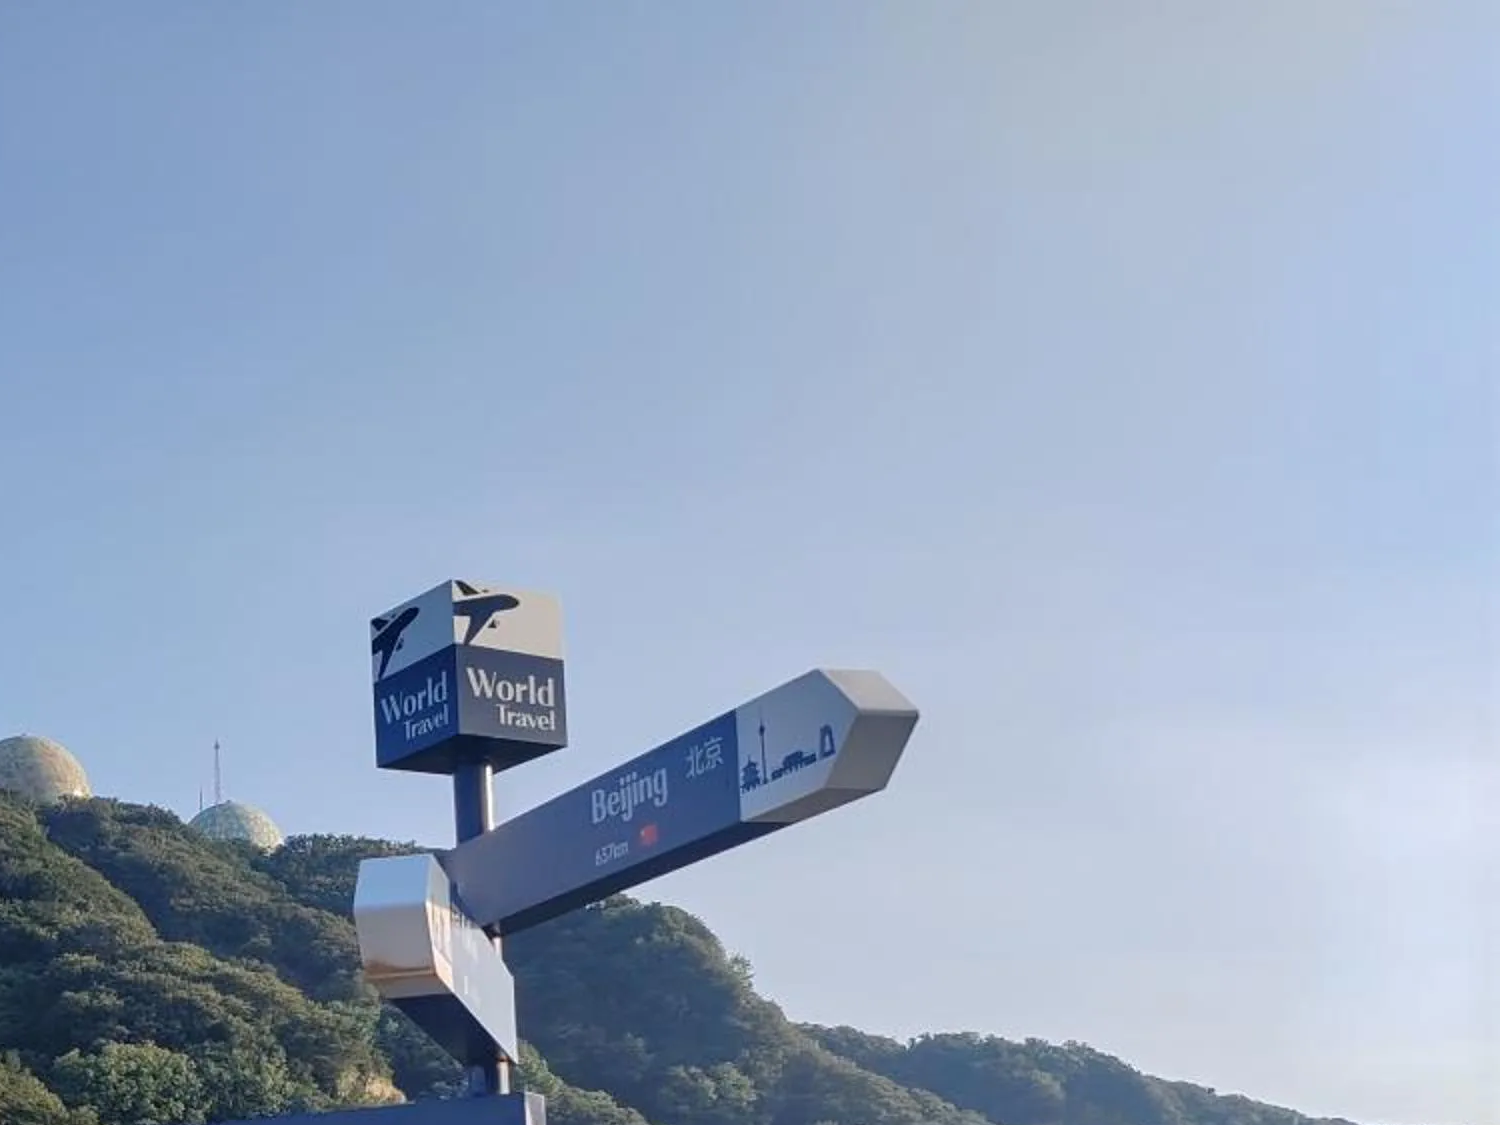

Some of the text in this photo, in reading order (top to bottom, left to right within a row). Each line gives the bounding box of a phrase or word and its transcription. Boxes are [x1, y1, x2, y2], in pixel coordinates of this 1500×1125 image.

[380, 671, 448, 725] World
[466, 667, 555, 707] World
[403, 704, 449, 741] Travel
[496, 703, 555, 731] Travel
[591, 736, 724, 825] Beijing 北京
